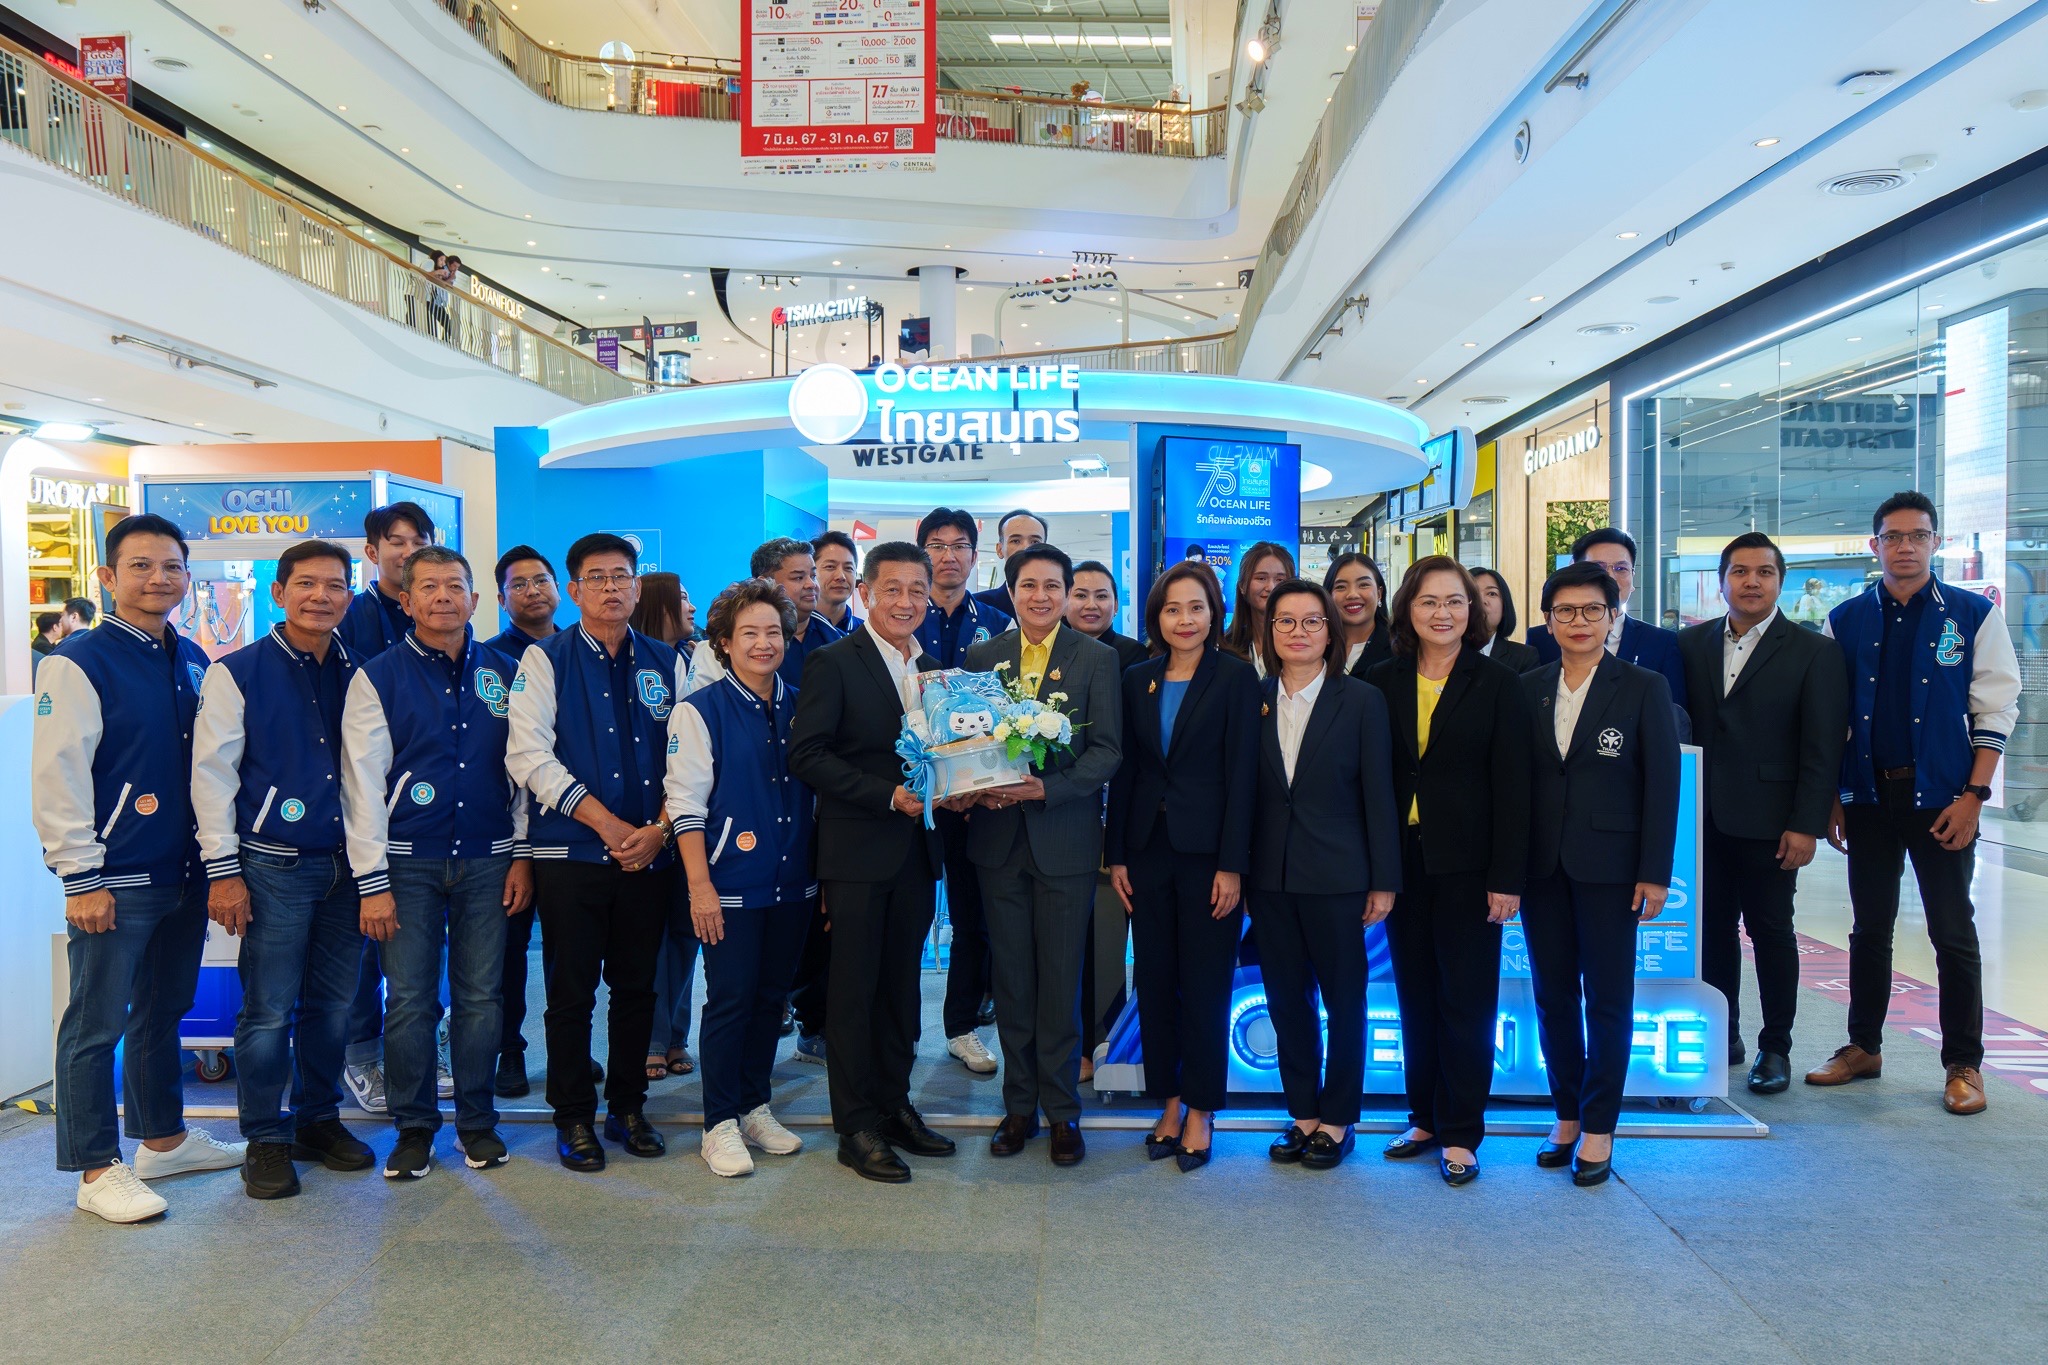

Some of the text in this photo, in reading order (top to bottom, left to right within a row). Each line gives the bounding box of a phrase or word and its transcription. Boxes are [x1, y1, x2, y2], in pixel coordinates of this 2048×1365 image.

[763, 134, 771, 145] 7
[773, 133, 798, 145] มิ.ย.
[801, 133, 817, 145] 67
[829, 132, 841, 145] 31
[845, 134, 869, 144] ก.ค.
[873, 131, 889, 143] 67
[1240, 274, 1248, 289] 2
[572, 334, 580, 346] 2
[875, 362, 1080, 393] OCEAN LIFE
[876, 399, 1080, 455] ไทยสมุทร
[852, 443, 984, 467] WESTGATE
[1524, 426, 1600, 476] GIORDANO
[27, 477, 97, 509] URORA
[222, 489, 292, 512] OCHI
[1210, 497, 1271, 510] OCEAN LIFE
[209, 515, 310, 534] LOVE YOU
[1196, 513, 1271, 526] รักคือพลังของชีวิต
[1205, 555, 1232, 566] 530%
